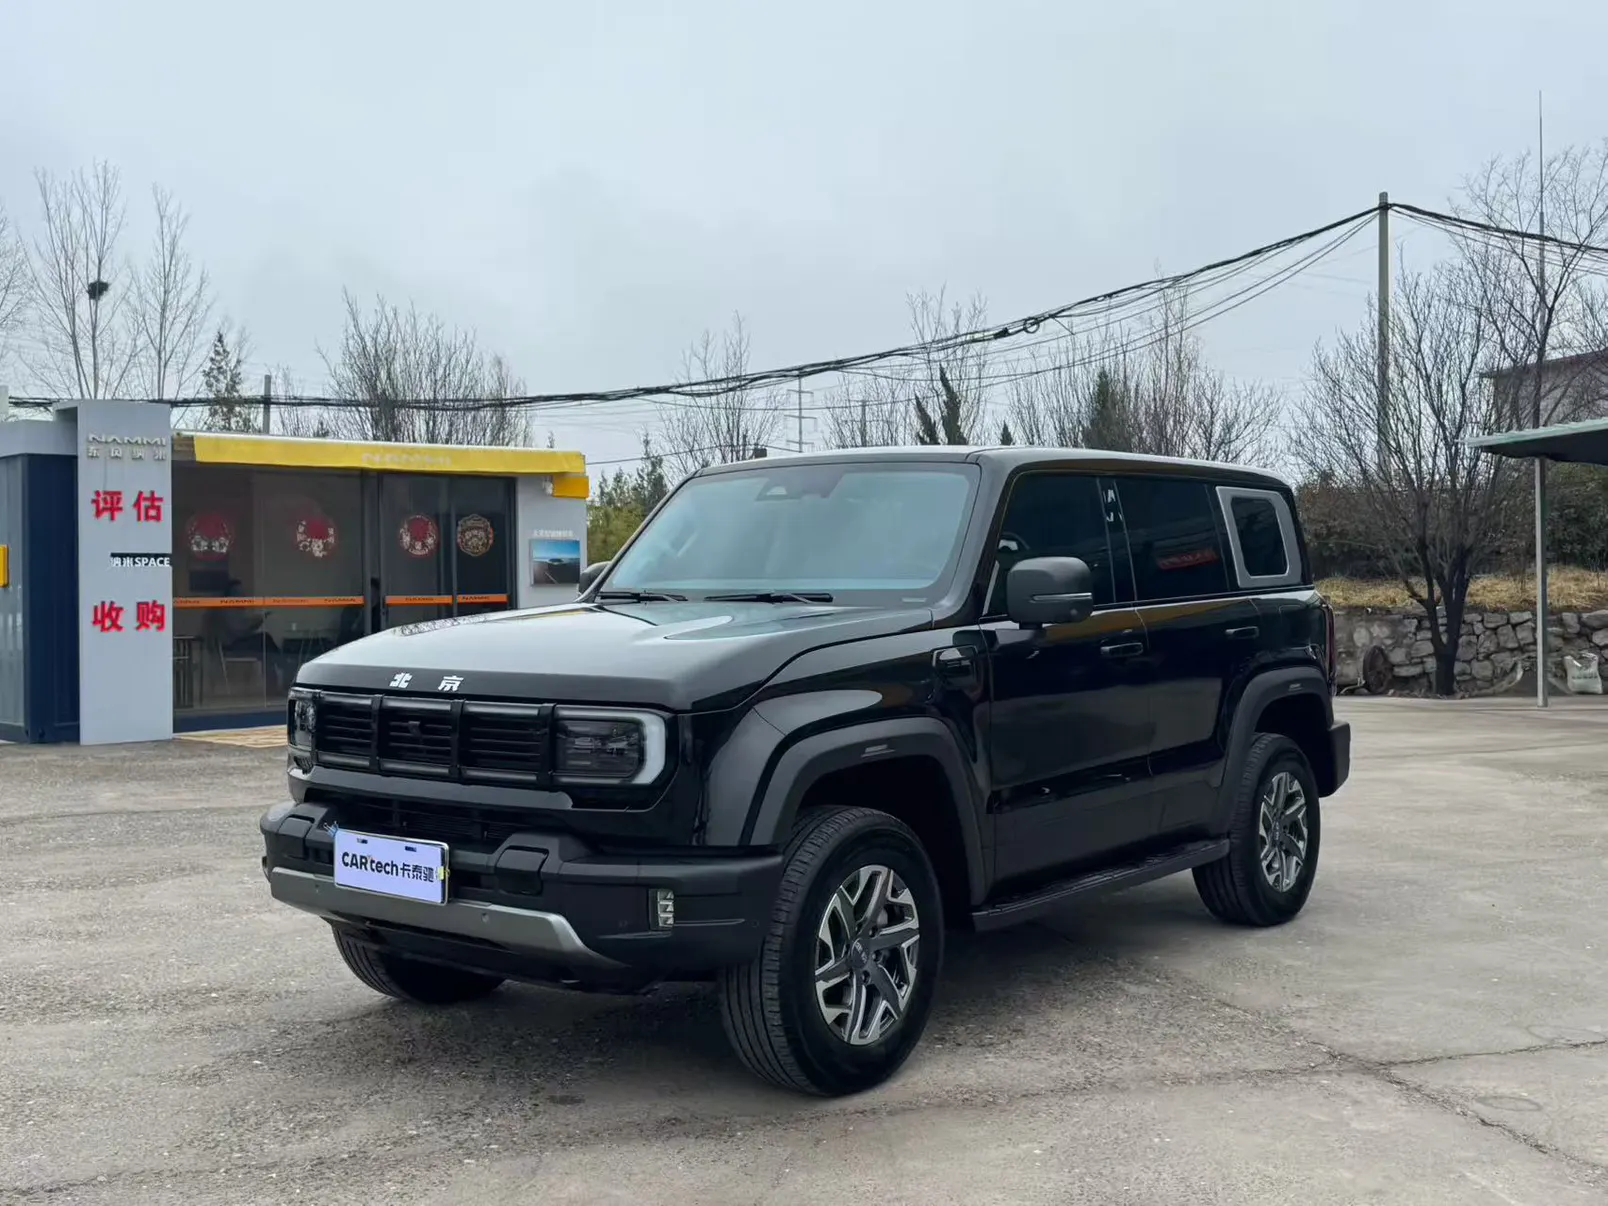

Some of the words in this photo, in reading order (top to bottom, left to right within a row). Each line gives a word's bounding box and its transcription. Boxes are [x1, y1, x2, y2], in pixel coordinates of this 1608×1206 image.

[88, 433, 166, 446] NAMMI
[91, 490, 164, 522] 评估
[92, 600, 166, 632] 收购
[389, 672, 464, 692] 北京
